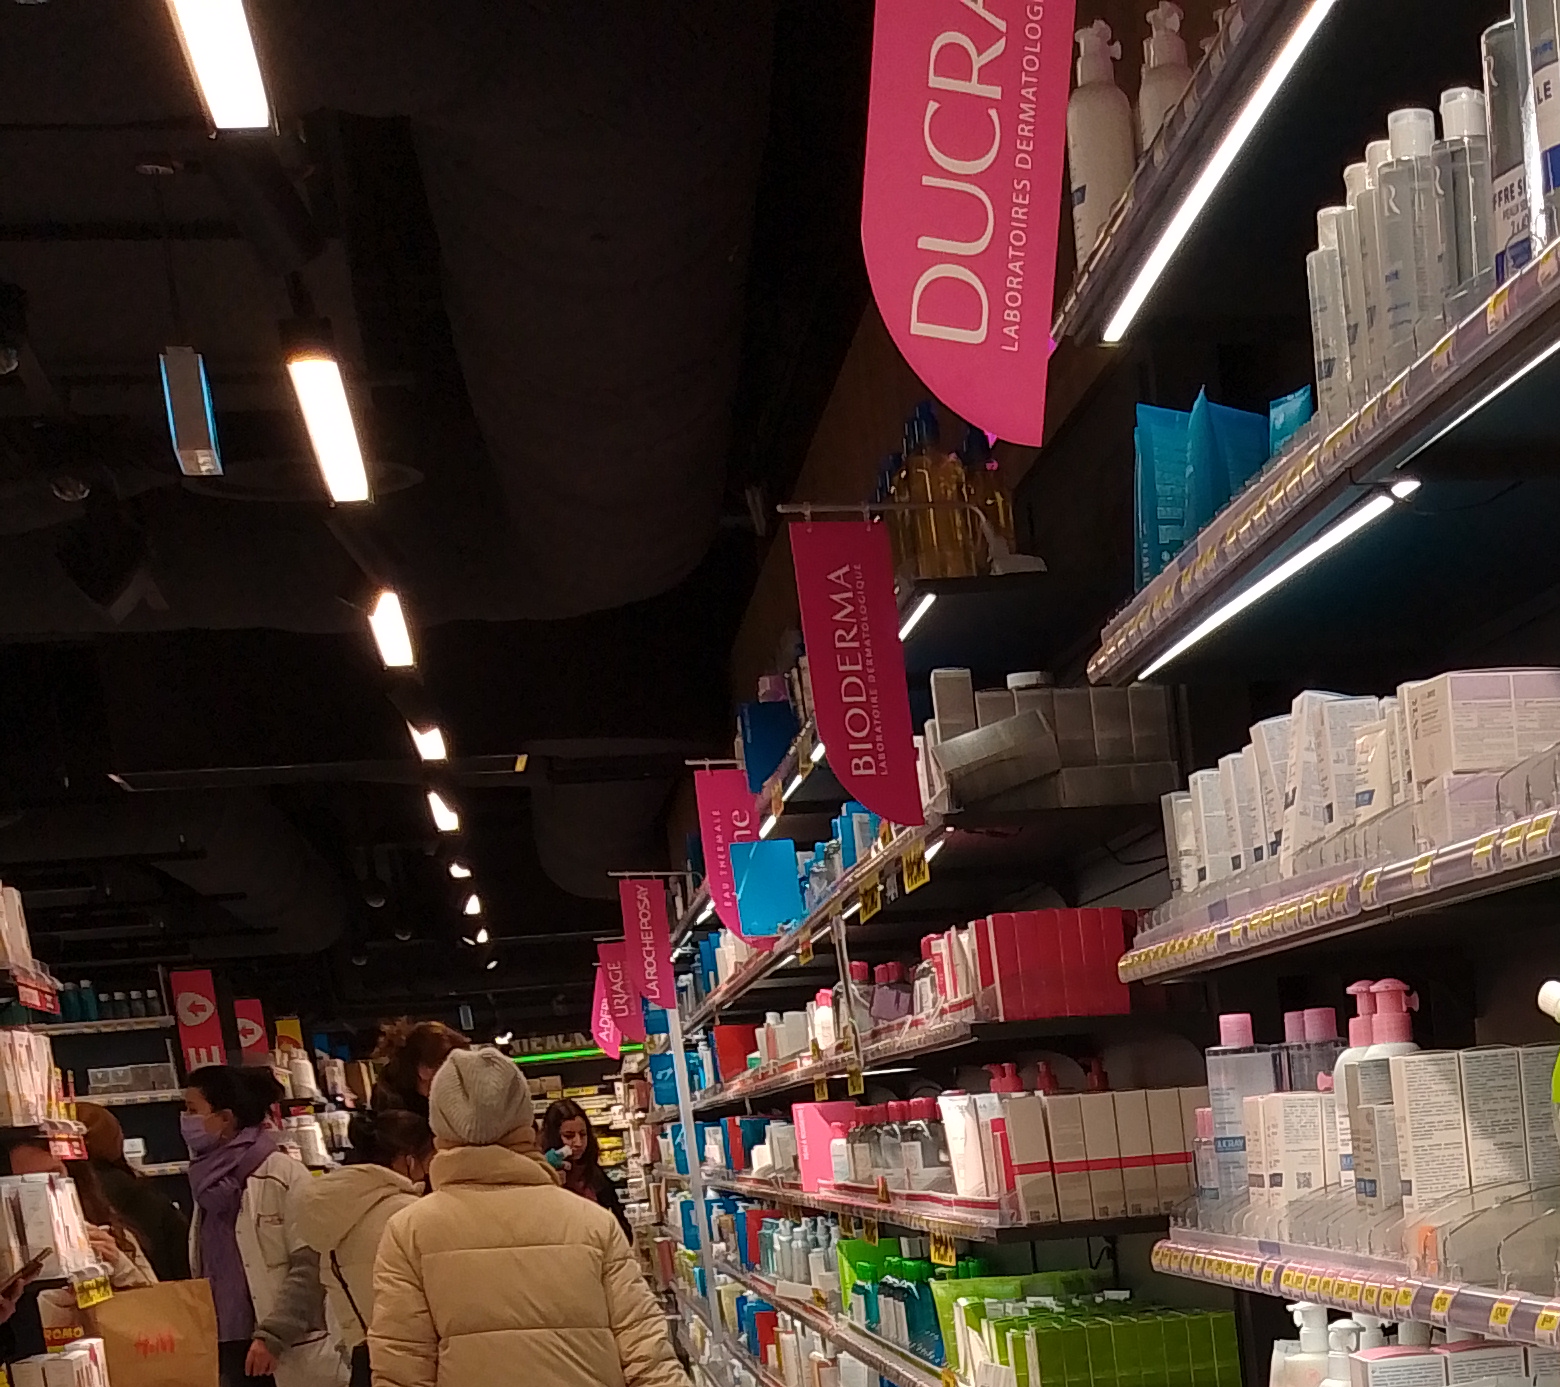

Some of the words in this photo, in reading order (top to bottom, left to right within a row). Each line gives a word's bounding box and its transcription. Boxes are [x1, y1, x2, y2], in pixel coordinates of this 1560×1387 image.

[1014, 0, 1044, 170] DERMATOLOG
[1001, 178, 1032, 353] LABORATOIRES
[827, 563, 877, 776] BIODERMA
[853, 563, 876, 682] DERMATOLOGIQUE
[871, 688, 888, 776] LABORATOIRE
[710, 809, 728, 876] THERMALE
[606, 960, 630, 1018] URIAGE
